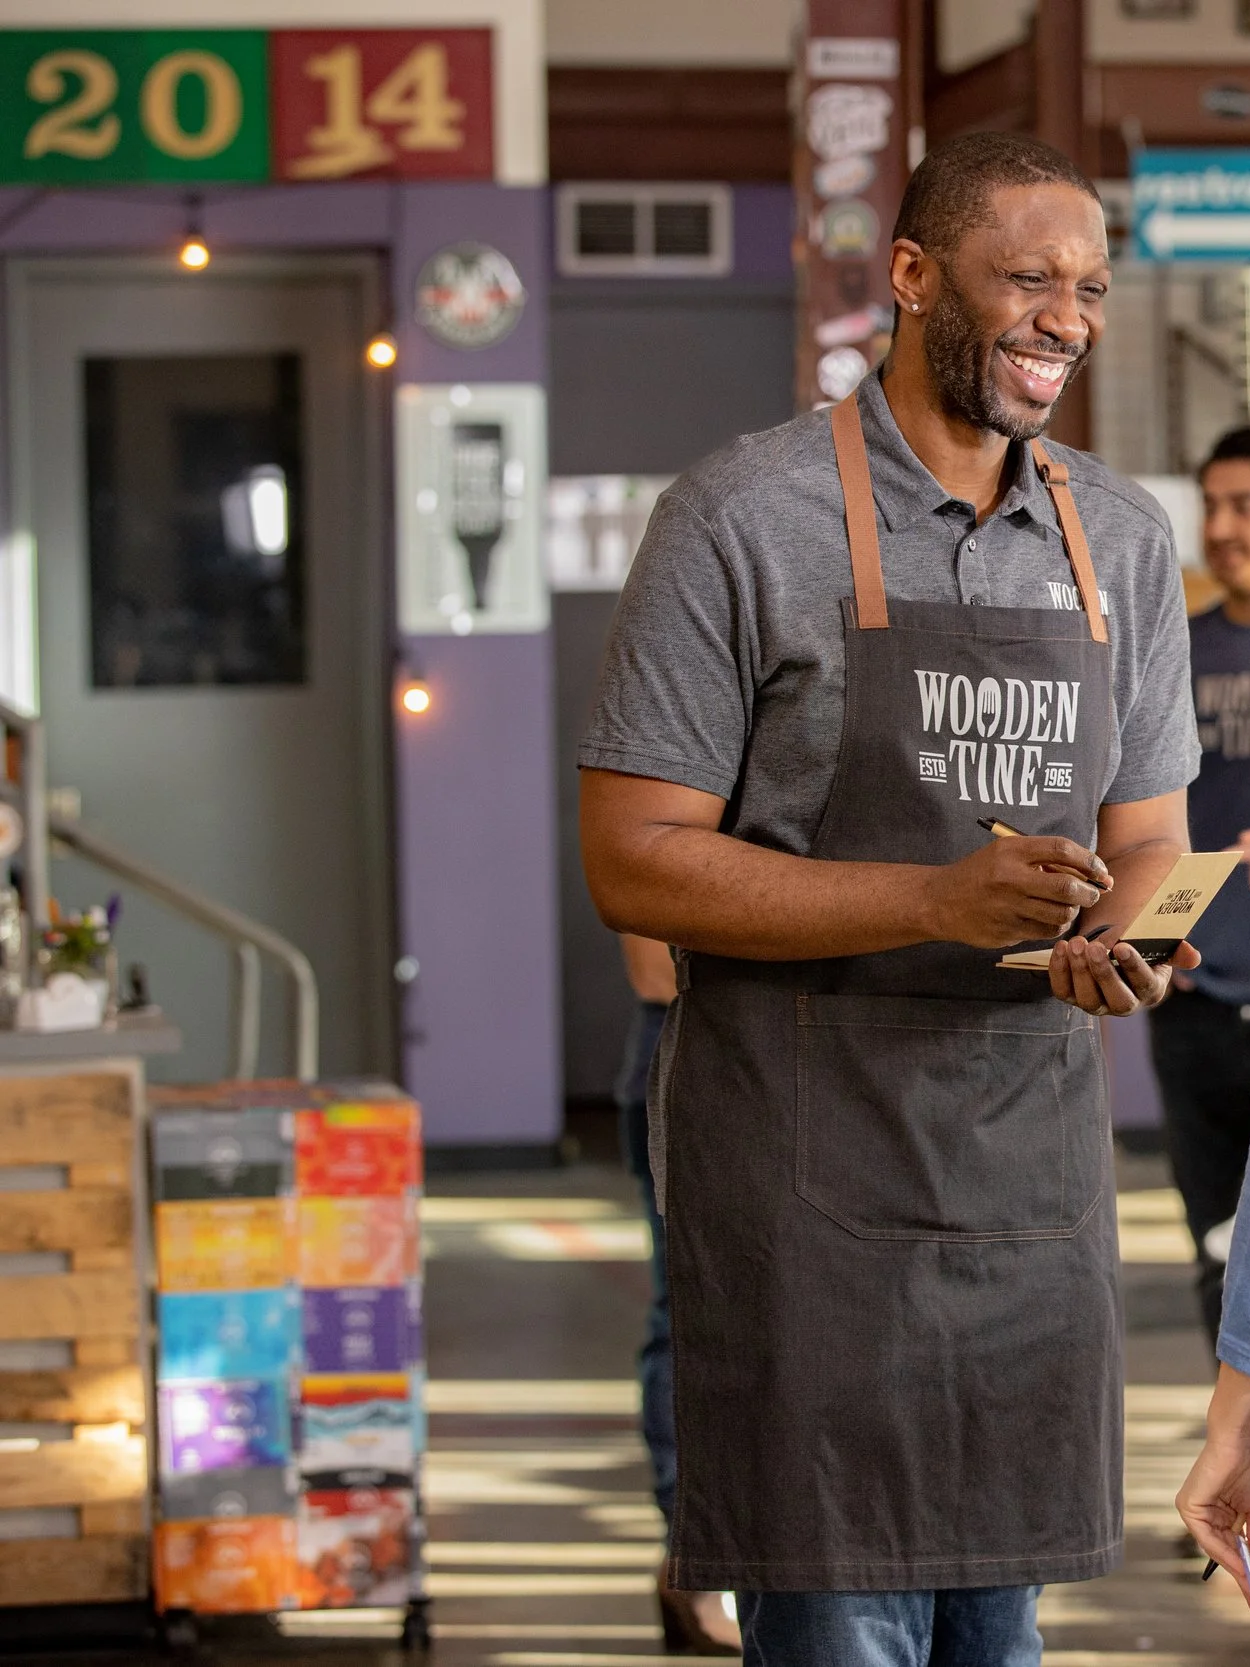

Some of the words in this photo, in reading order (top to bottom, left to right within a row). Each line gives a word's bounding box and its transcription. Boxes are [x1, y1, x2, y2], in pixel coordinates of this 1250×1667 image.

[914, 669, 1080, 743] WOODEN
[919, 756, 947, 778] ESTD
[949, 739, 1043, 806] TINE
[1044, 767, 1073, 787] 1965
[1154, 901, 1195, 914] WOODEN
[1170, 889, 1196, 902] TINE
